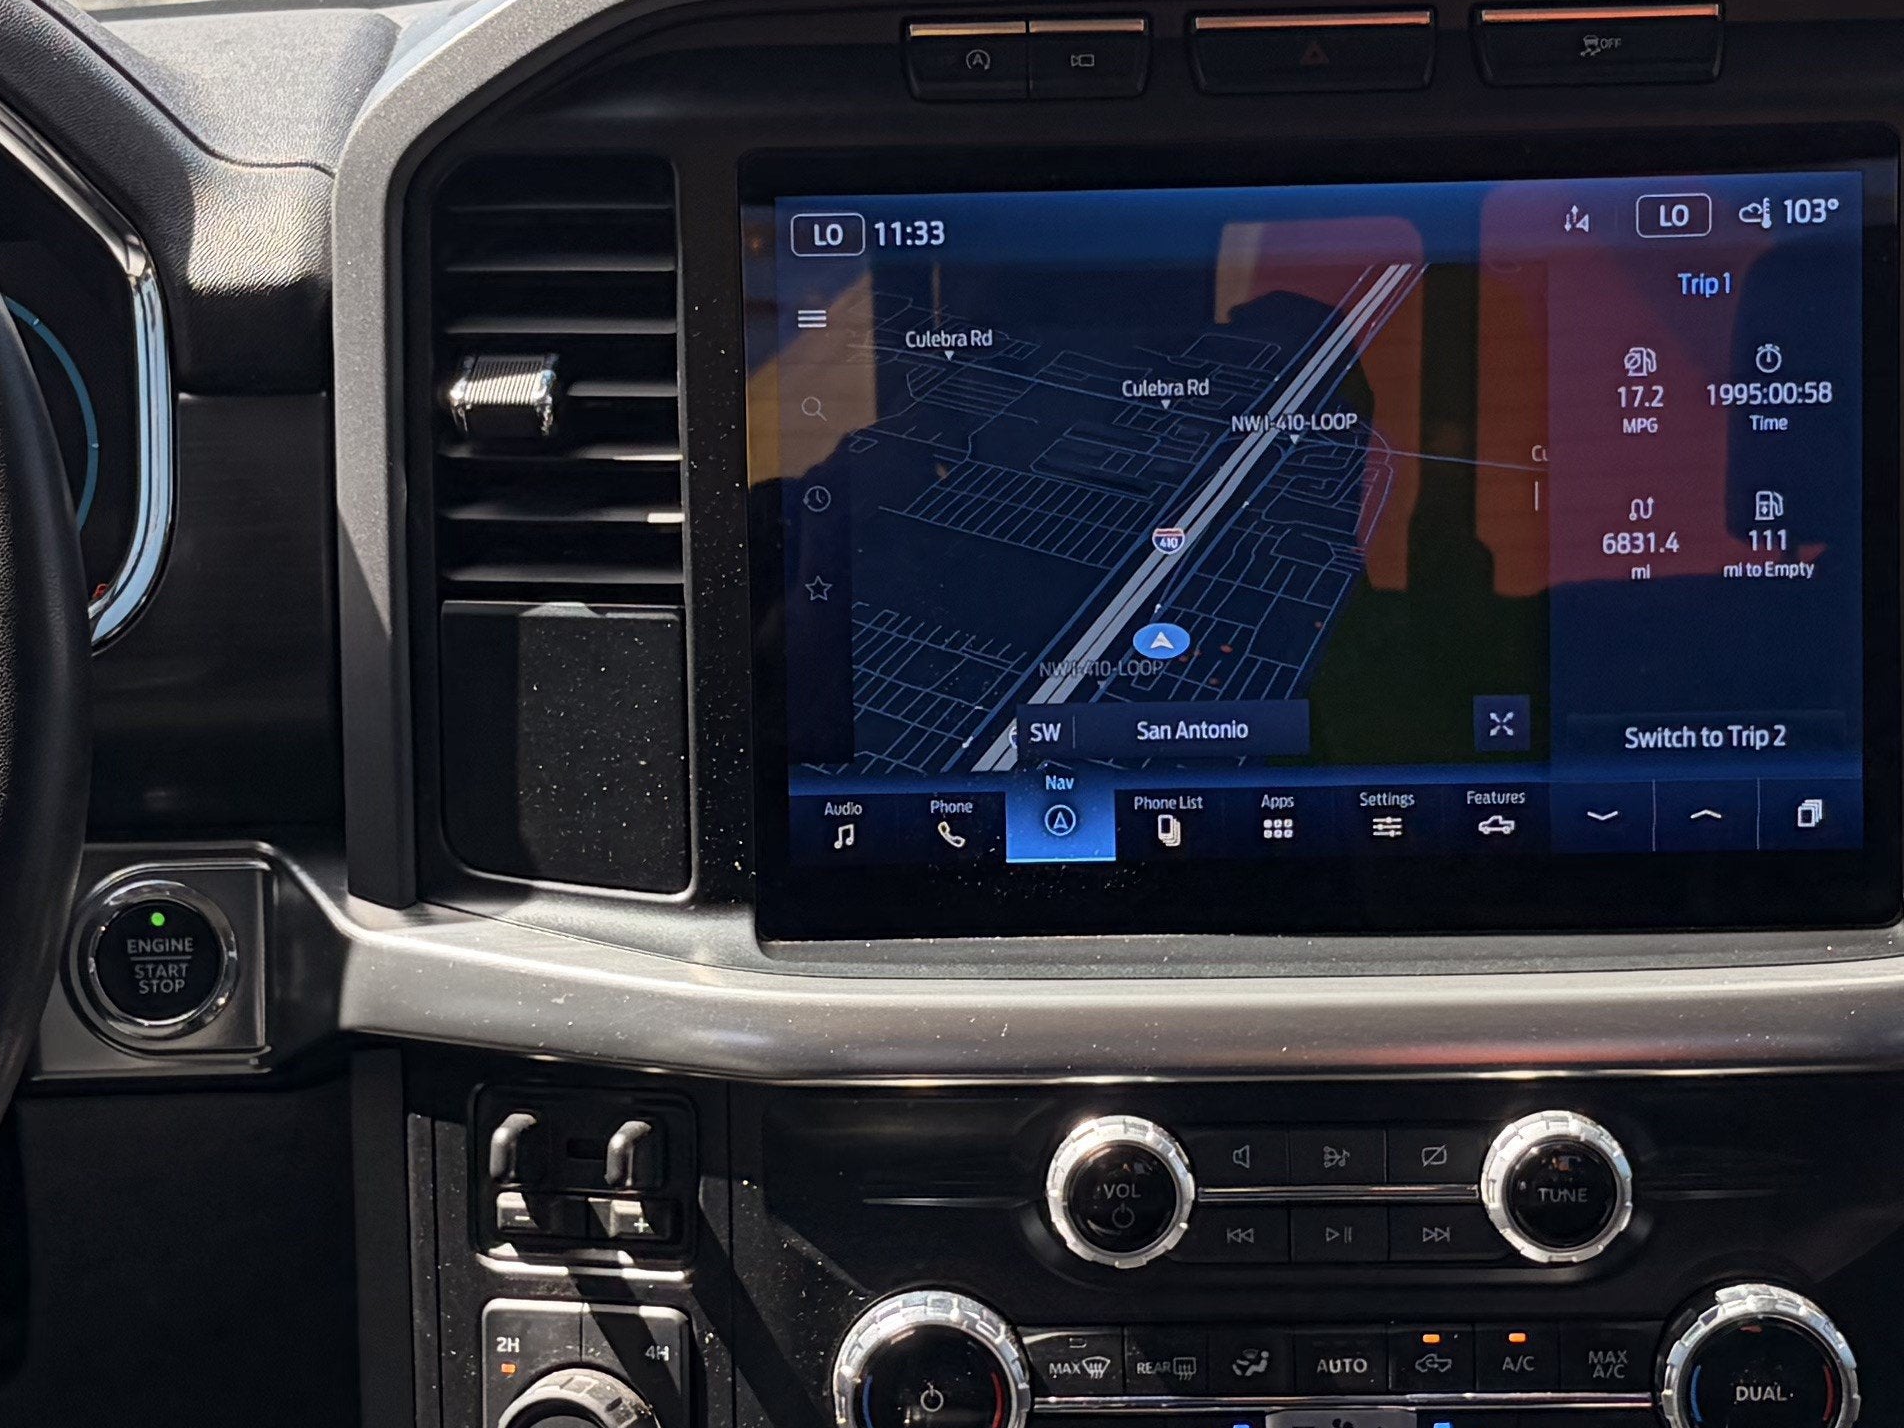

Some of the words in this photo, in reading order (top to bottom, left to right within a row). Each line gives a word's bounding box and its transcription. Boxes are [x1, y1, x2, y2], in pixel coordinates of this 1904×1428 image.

[1601, 37, 1622, 50] OFF
[1660, 205, 1690, 227] LO
[1783, 199, 1840, 224] 103°
[813, 224, 844, 247] LO
[874, 220, 946, 247] 11:33
[1678, 272, 1722, 298] Trip
[905, 329, 969, 349] Culebra
[971, 329, 993, 348] Rd
[1122, 378, 1186, 398] Culebra
[1187, 378, 1210, 397] Rd
[1617, 386, 1665, 408] 17.2
[1706, 383, 1833, 406] 1995:00:58
[1231, 414, 1260, 432] NW
[1261, 412, 1358, 432] I-410-LOOP
[1622, 417, 1659, 434] MPG
[1749, 414, 1789, 432] Time
[1158, 535, 1179, 551] 410
[1601, 530, 1681, 555] 6831.4
[1748, 529, 1788, 551] 111
[1631, 564, 1651, 580] mi
[1723, 563, 1742, 578] mi
[1744, 562, 1762, 577] to
[1765, 560, 1815, 580] Empty
[1029, 722, 1061, 742] SW
[1136, 720, 1172, 741] San
[1175, 719, 1249, 741] Antonio
[1624, 725, 1697, 749] Switch
[1700, 726, 1724, 748] to
[1727, 725, 1768, 751] Trip
[1772, 724, 1787, 747] 2
[1045, 774, 1075, 791] Nav
[1133, 795, 1174, 811] Phone
[1177, 794, 1203, 811] List
[1261, 793, 1294, 811] Apps
[1359, 791, 1415, 811] Settings
[1466, 788, 1526, 806] Features
[824, 800, 863, 817] Audio
[930, 799, 973, 815] Phone
[126, 937, 195, 954] ENGINE
[134, 963, 190, 980] START
[139, 978, 186, 995] STOP
[1102, 1183, 1142, 1200] VOL
[1537, 1186, 1588, 1203] TUNE
[496, 1335, 521, 1355] 2H
[644, 1344, 670, 1363] 4H
[1316, 1358, 1368, 1374] AUTO
[1502, 1355, 1535, 1373] A/C
[1588, 1349, 1629, 1366] MAX
[1049, 1361, 1082, 1376] MAX
[1136, 1361, 1171, 1375] REAR
[1593, 1362, 1626, 1379] A/C
[1734, 1385, 1788, 1403] DUAL
